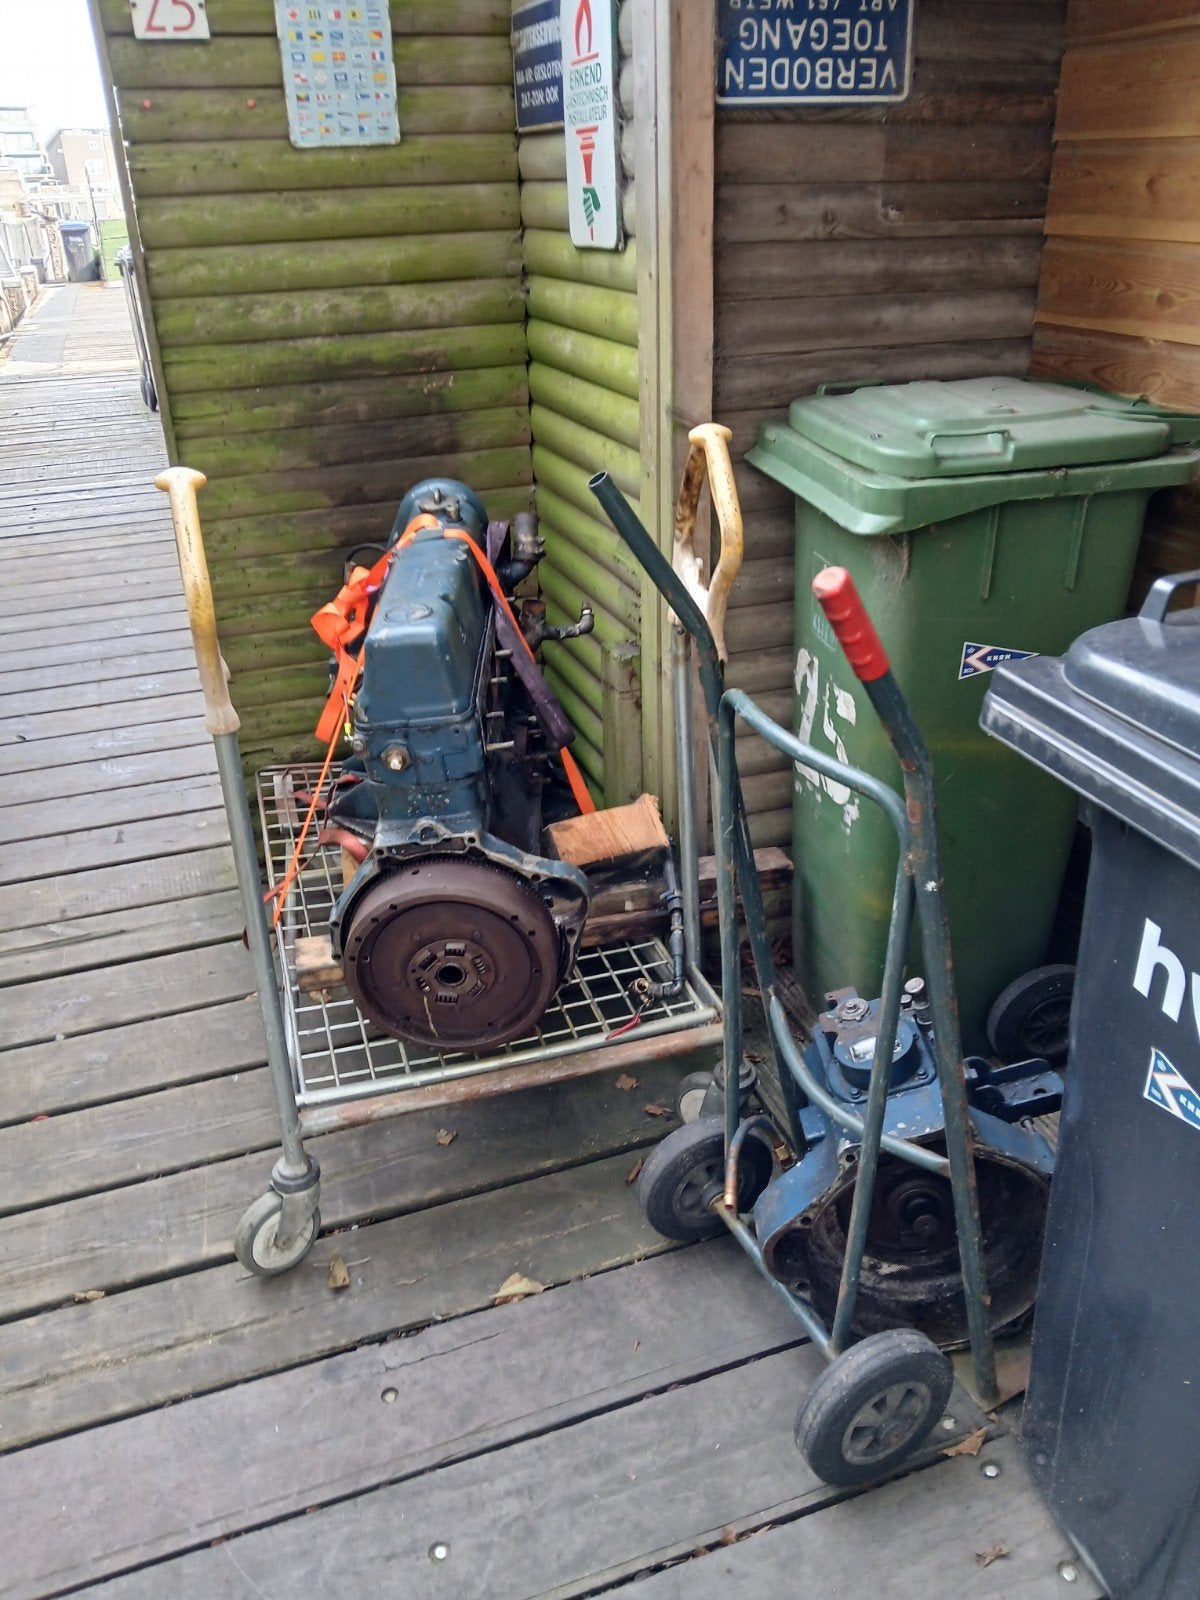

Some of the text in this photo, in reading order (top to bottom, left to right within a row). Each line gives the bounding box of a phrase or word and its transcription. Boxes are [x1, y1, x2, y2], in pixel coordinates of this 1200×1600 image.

[739, 17, 888, 51] TOEGANG
[569, 62, 602, 90] ERKEND
[725, 57, 897, 90] VERBODEN
[545, 84, 560, 104] OOK
[568, 104, 608, 127] INSTALLATEUR
